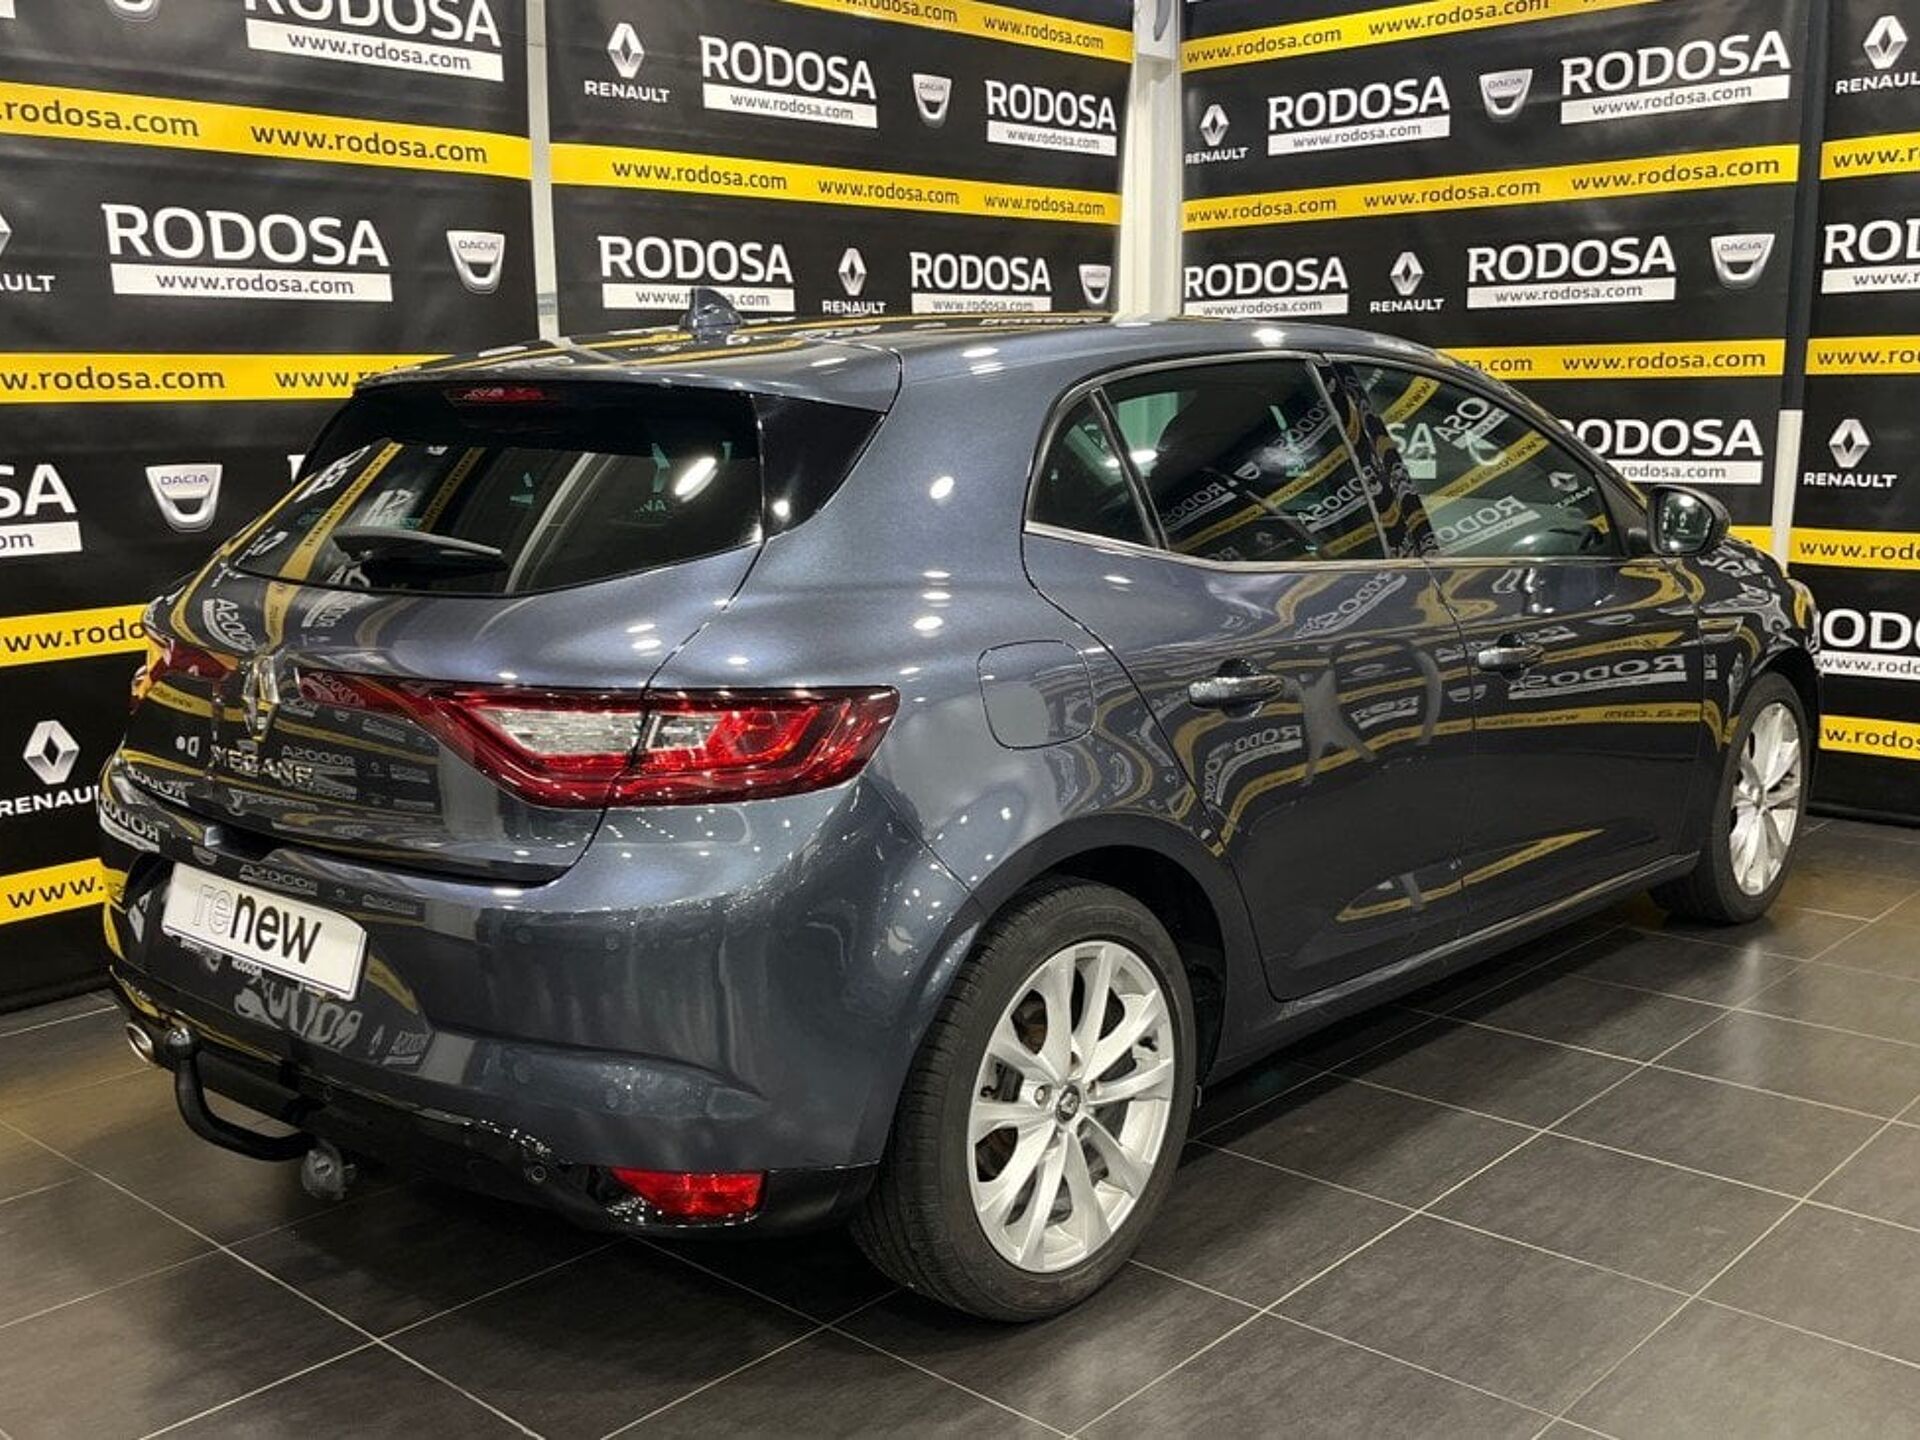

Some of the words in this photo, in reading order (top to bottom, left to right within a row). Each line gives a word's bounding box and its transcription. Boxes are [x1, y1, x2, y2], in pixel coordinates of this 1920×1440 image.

[245, 0, 502, 47] DOSA
[983, 15, 1104, 50] www.rodosa.com
[287, 31, 471, 70] www.rodosa.com
[1187, 26, 1342, 62] www.rodosa.com
[699, 35, 876, 99] RODOSA
[1561, 30, 1791, 95] RODOSA
[584, 80, 670, 102] RENAULT
[1592, 84, 1752, 116] www.rodosa.com
[1835, 72, 1920, 95] RENAUL
[730, 93, 853, 120] www.rodosa.com
[985, 80, 1117, 131] RODOSA
[1268, 76, 1450, 130] RODOSA
[251, 125, 487, 163] www.rodosa.com
[1007, 129, 1100, 150] www.rodosa.com
[1293, 123, 1421, 149] www.rodosa.com
[1185, 147, 1249, 165] RENAULT
[1833, 147, 1920, 169] www.r
[613, 160, 788, 190] www.rodosa.com
[817, 177, 960, 205] www.rodosa.com
[984, 193, 1105, 217] www.rodosa.com
[1187, 197, 1336, 223] www.rodosa.com
[1363, 180, 1540, 209] www.rodosa.com
[1571, 158, 1780, 191] www.rodosa.com
[101, 203, 390, 267] RODOSA
[598, 236, 793, 283] RODOSA
[909, 252, 1051, 292] RODOSA
[1467, 236, 1677, 283] RODOSA
[156, 272, 354, 294] www.rodosa.com
[1184, 257, 1348, 299] RODOSA
[1494, 284, 1644, 303] www.rodosa.com
[822, 300, 886, 315] RENAULT
[1202, 298, 1323, 316] www.rodosa.com
[1370, 298, 1444, 314] RENAULT
[1563, 351, 1766, 371] www.rodosa.com
[1817, 350, 1920, 366] www.ro
[1560, 418, 1764, 456] ODOSA
[161, 473, 211, 486] DACIA
[1803, 472, 1898, 488] RENAULT
